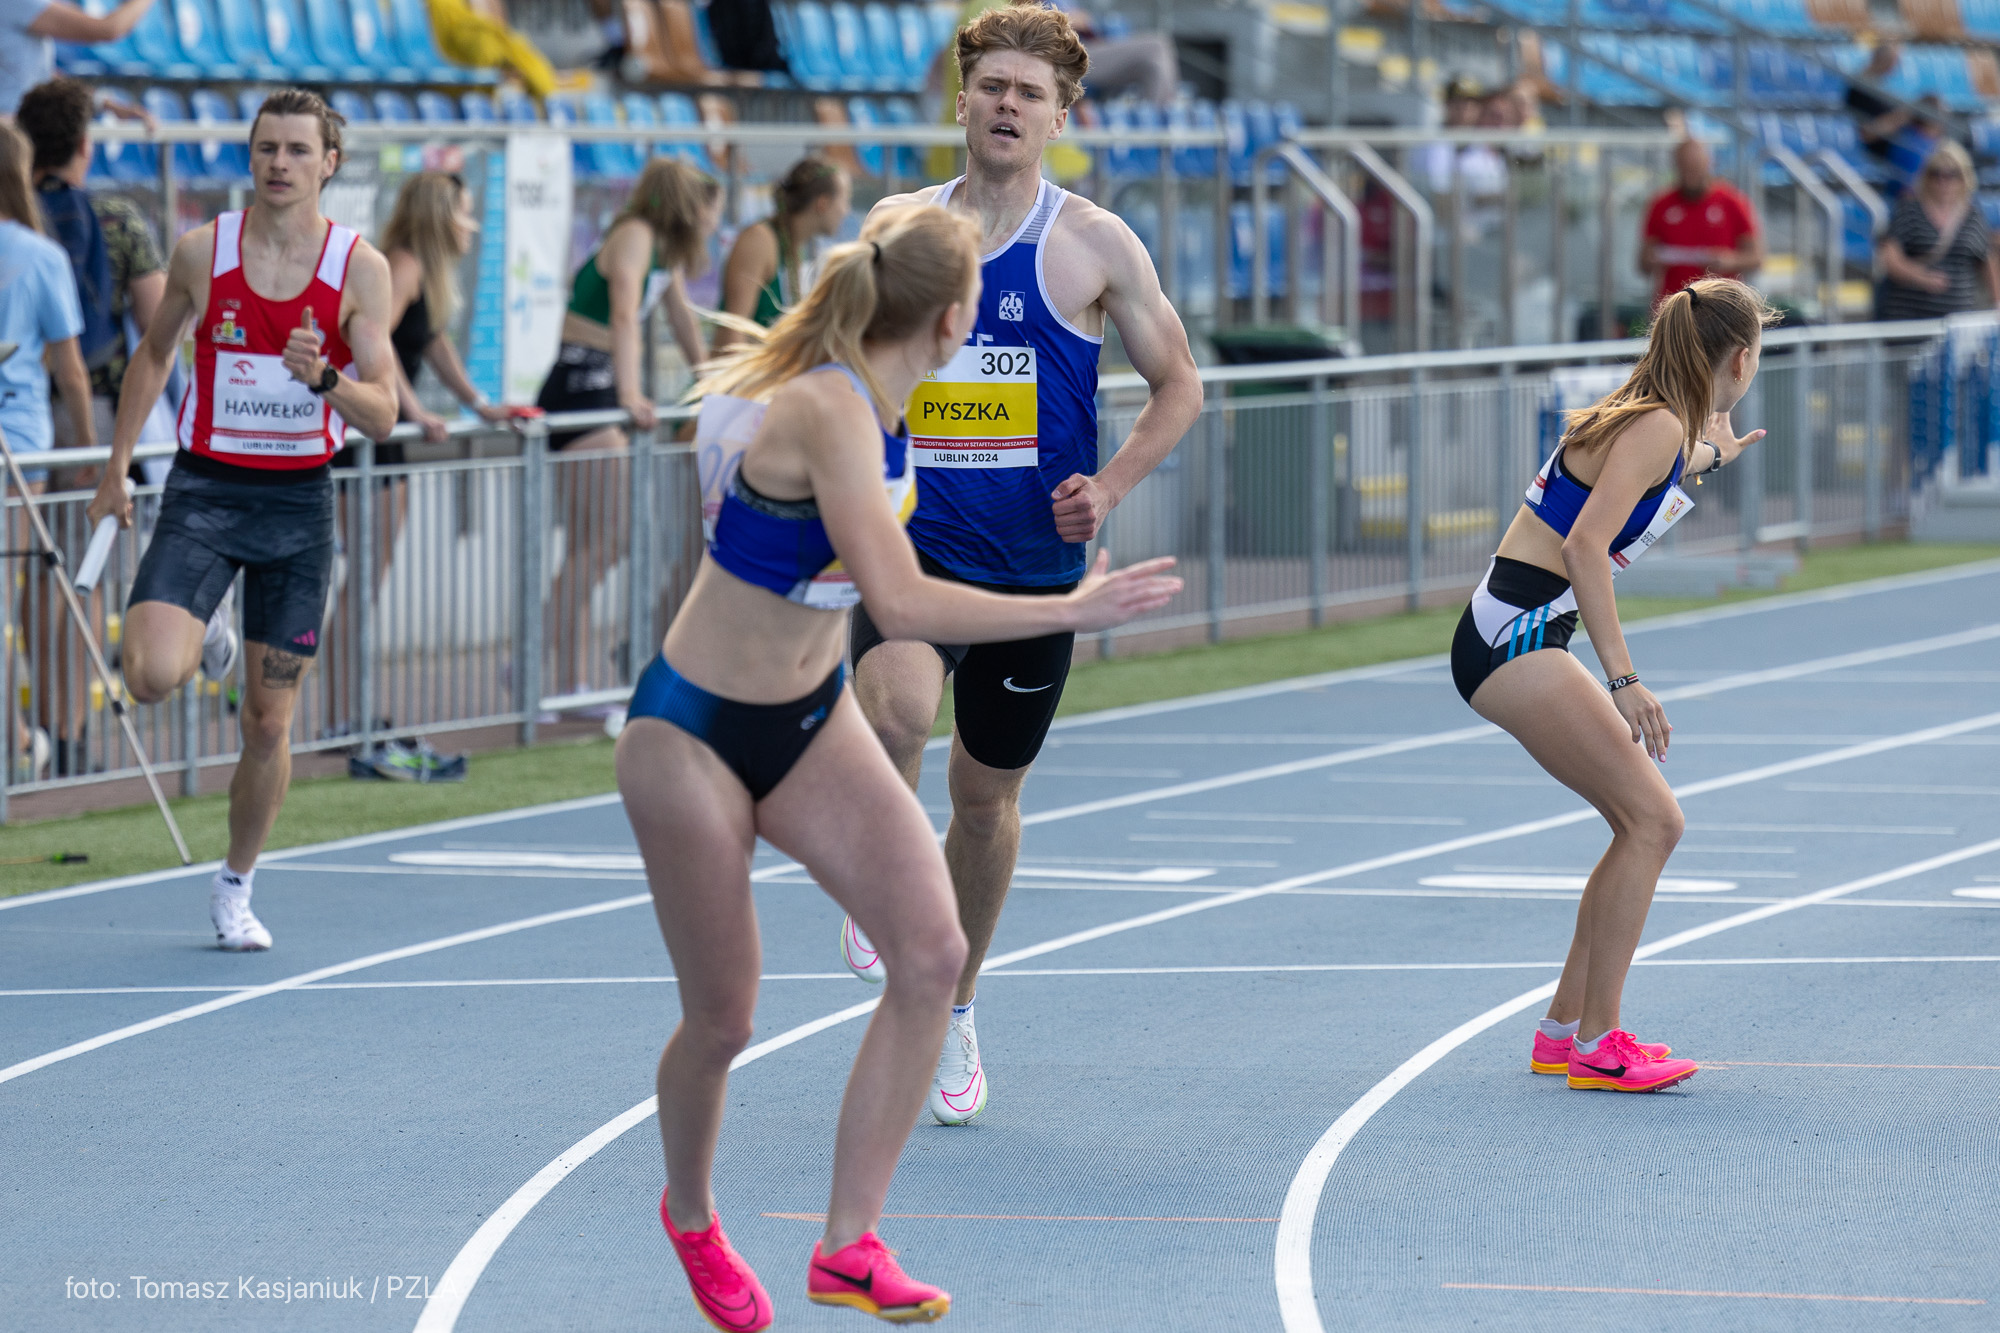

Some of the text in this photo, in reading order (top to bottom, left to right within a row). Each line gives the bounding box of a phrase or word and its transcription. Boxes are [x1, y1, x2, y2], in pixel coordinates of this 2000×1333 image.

[980, 352, 1031, 376] 302
[225, 398, 315, 419] HAWEŁKO
[923, 401, 1010, 421] PYSZKA
[242, 441, 297, 451] LUBLIN 2024
[934, 453, 998, 463] LUBLIN 2024
